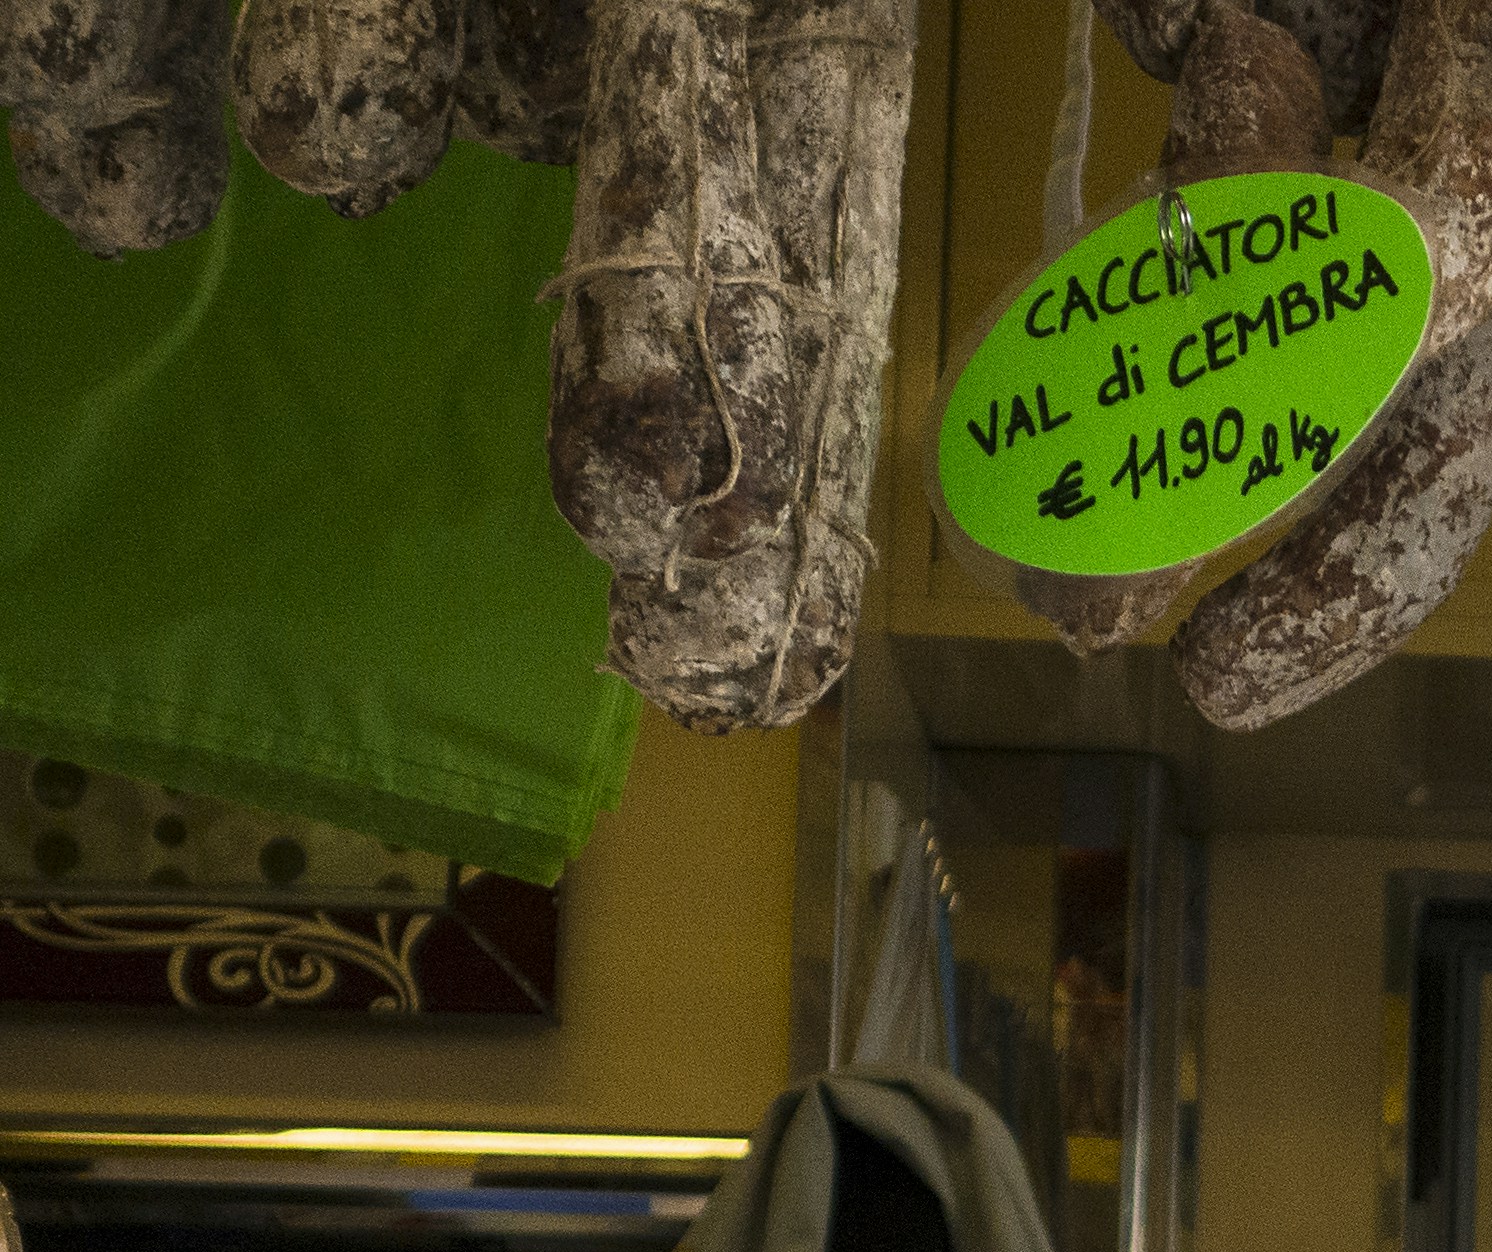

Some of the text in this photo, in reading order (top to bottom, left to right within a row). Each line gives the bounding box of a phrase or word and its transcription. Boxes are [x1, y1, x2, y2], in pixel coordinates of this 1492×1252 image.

[1025, 191, 1339, 338] CACCIATORI
[967, 249, 1399, 456] VAL di CEMBRA
[1037, 461, 1096, 519] €
[1111, 406, 1243, 499] 11.90
